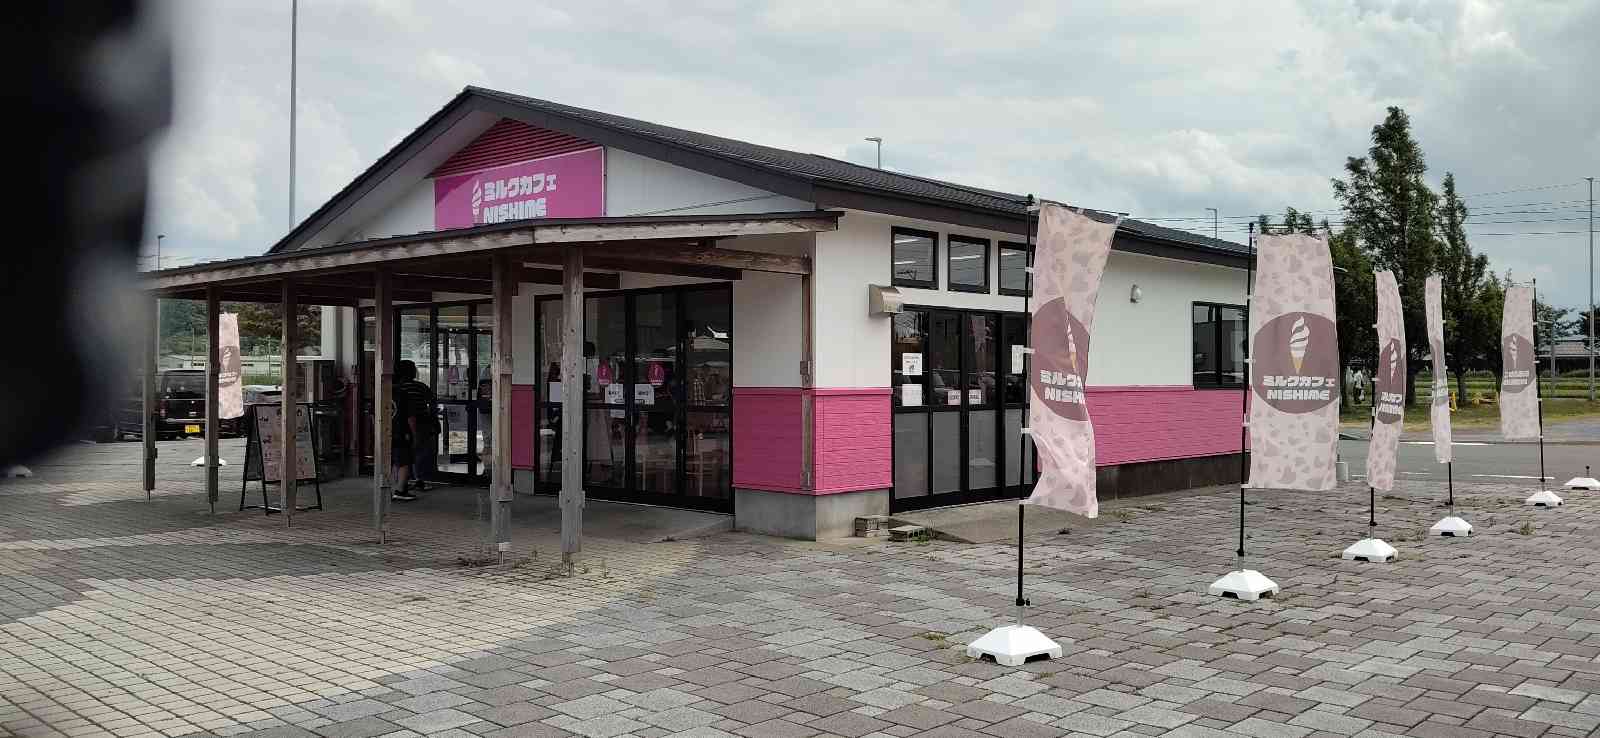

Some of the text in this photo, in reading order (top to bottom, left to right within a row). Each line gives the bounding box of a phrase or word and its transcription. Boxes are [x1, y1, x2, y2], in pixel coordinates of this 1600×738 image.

[484, 172, 557, 202] ミルクカフェ
[483, 198, 547, 224] NISHIME
[1263, 375, 1336, 387] ミルクカフェ
[1266, 389, 1331, 401] NISHIME
